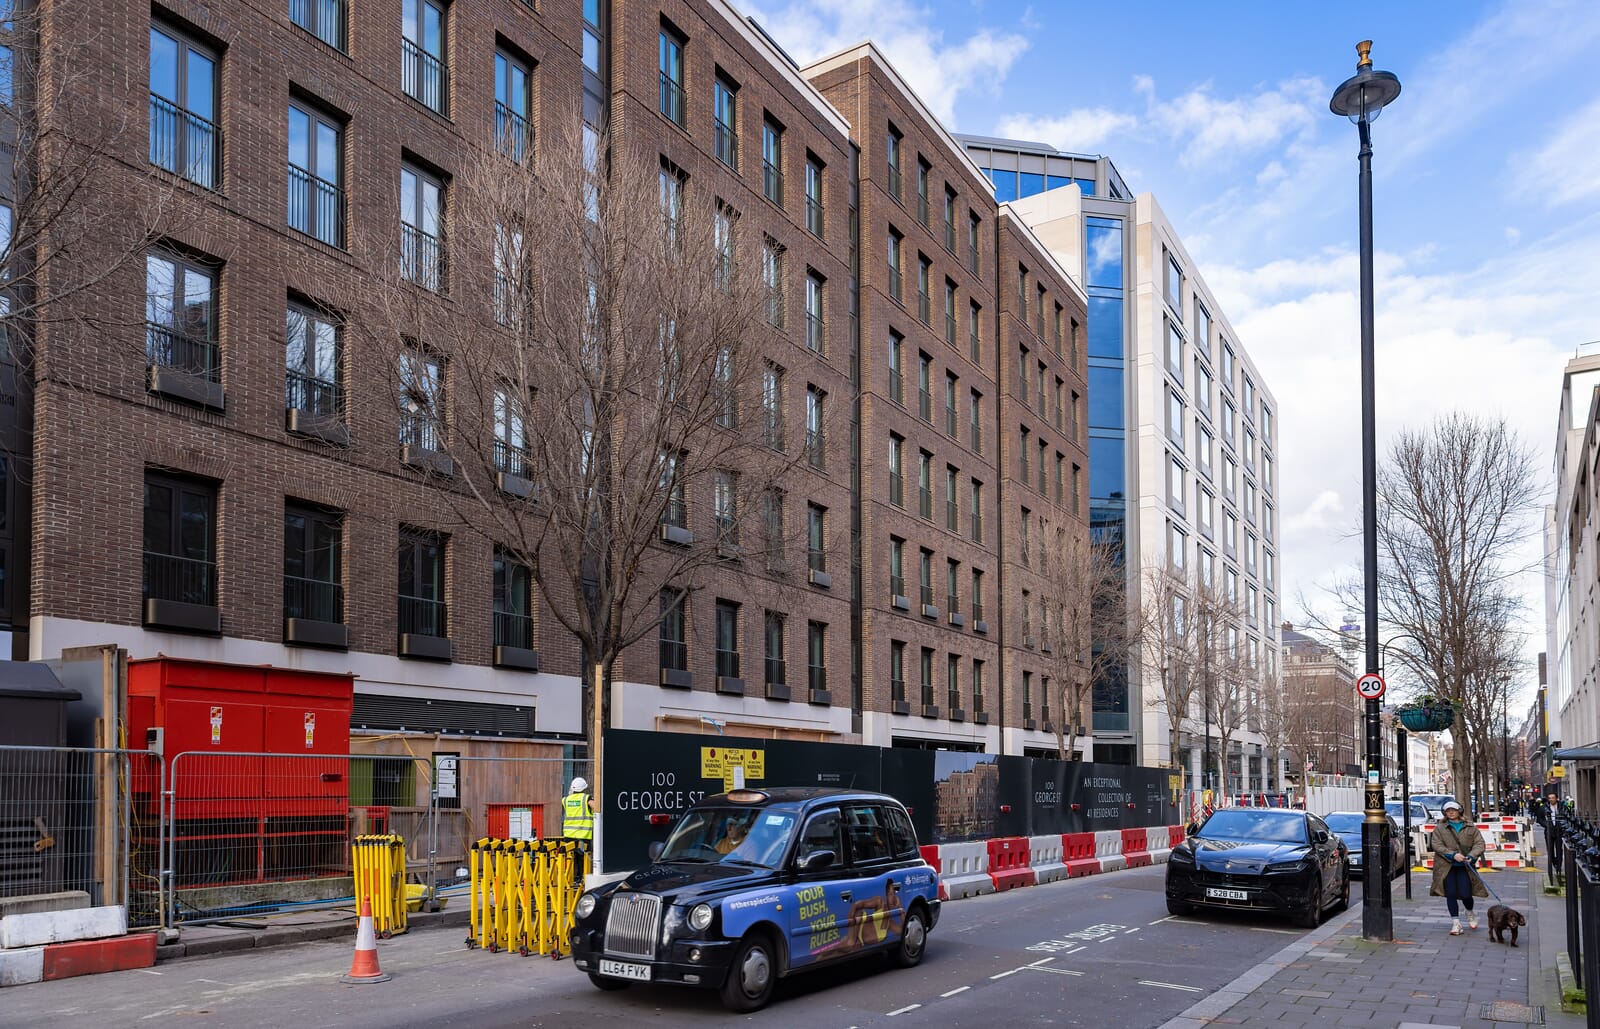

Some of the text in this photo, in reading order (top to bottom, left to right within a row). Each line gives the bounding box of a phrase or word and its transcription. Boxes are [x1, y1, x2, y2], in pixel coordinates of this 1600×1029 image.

[1361, 680, 1381, 692] 20
[651, 772, 676, 787] 100
[1083, 777, 1122, 789] AN EXCEPTIONAL
[617, 791, 684, 811] GEORGE
[1097, 792, 1132, 804] COLLECTION OF
[1093, 807, 1119, 818] RESIDENCES
[795, 885, 825, 904] YOUR
[799, 900, 829, 920] BUSH,
[809, 913, 837, 932] YOUR
[809, 928, 841, 949] RULES.
[603, 961, 647, 978] LL64 FVK
